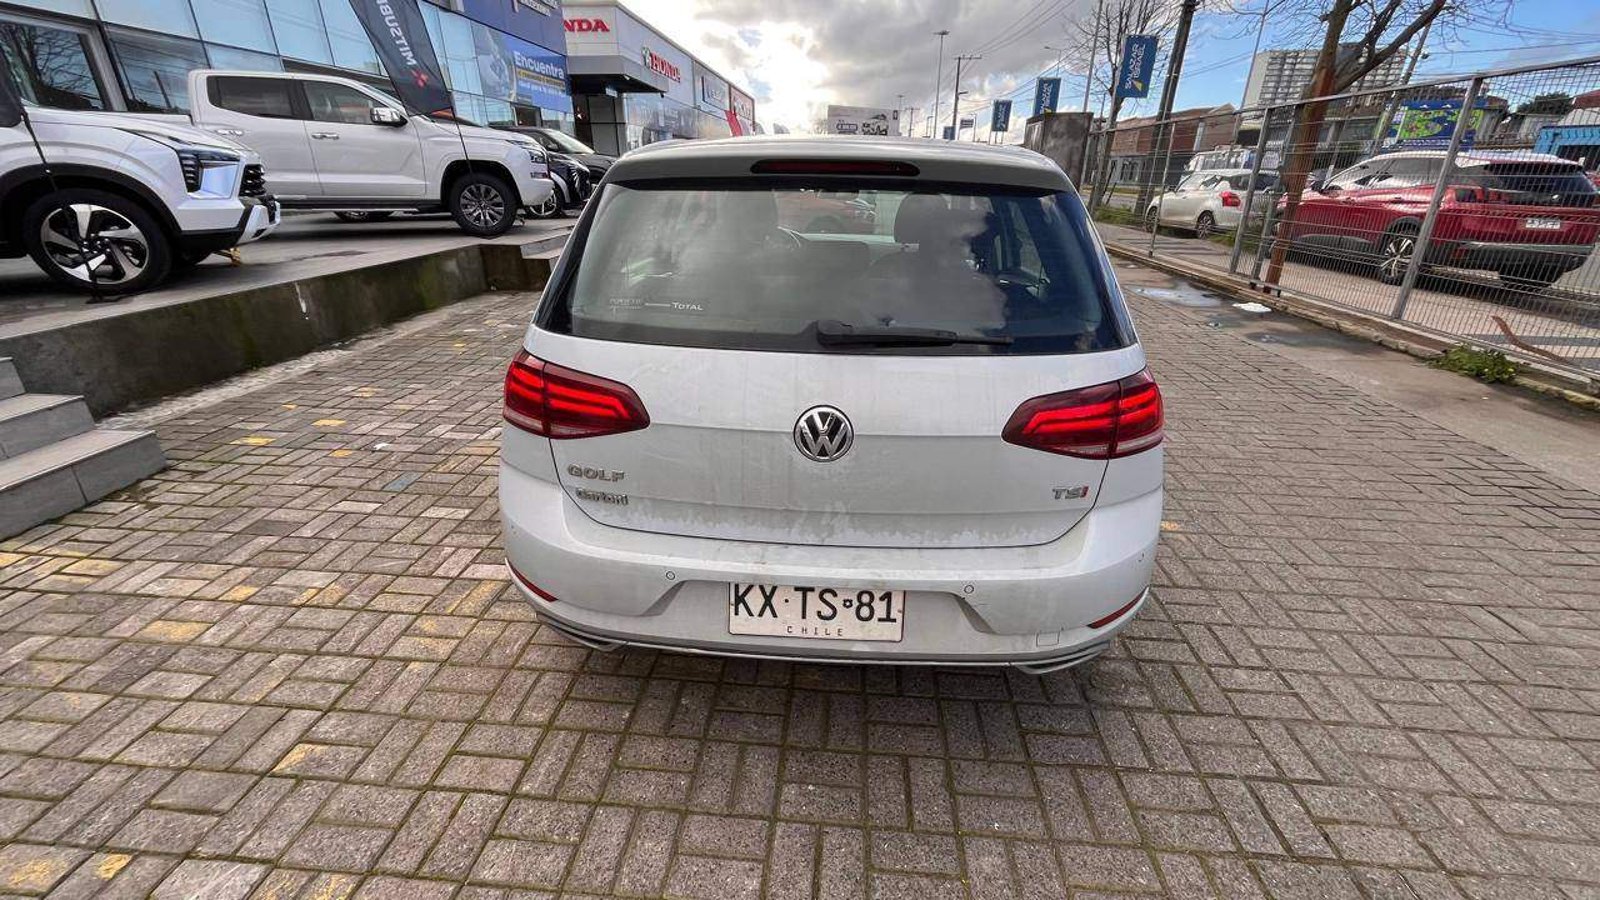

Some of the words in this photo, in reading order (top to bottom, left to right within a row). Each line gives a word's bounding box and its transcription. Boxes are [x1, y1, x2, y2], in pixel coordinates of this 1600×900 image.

[512, 50, 565, 80] Encuentra
[798, 409, 848, 459] VW
[567, 463, 625, 482] GOLF
[1052, 485, 1089, 500] TSI
[786, 625, 844, 637] CHILE
